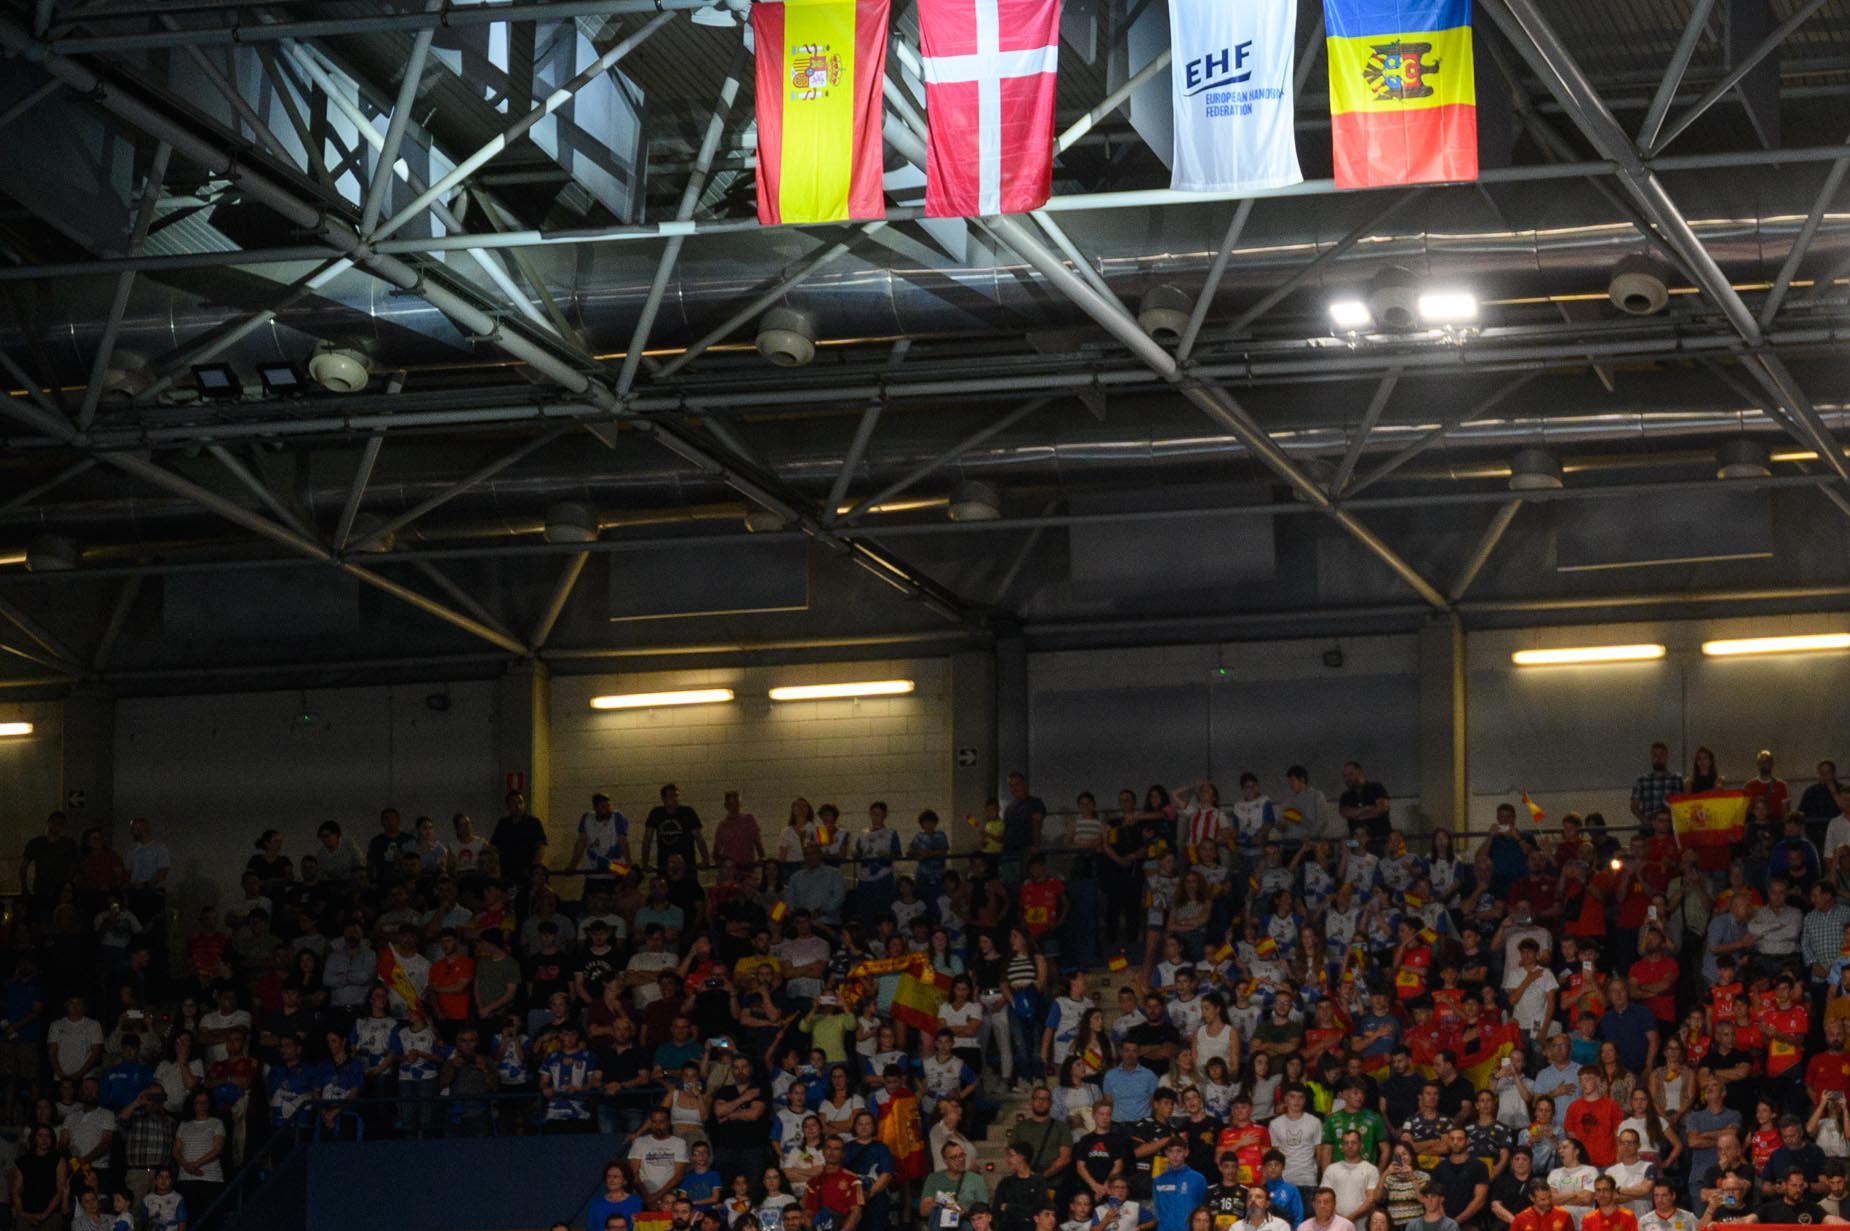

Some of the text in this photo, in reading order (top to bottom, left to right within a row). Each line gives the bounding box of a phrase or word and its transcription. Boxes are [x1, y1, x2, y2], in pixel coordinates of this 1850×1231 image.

[1185, 40, 1252, 89] EHF
[1206, 91, 1248, 105] EUROPEAN
[1206, 103, 1253, 117] FEDERATION
[1221, 1197, 1233, 1210] 16
